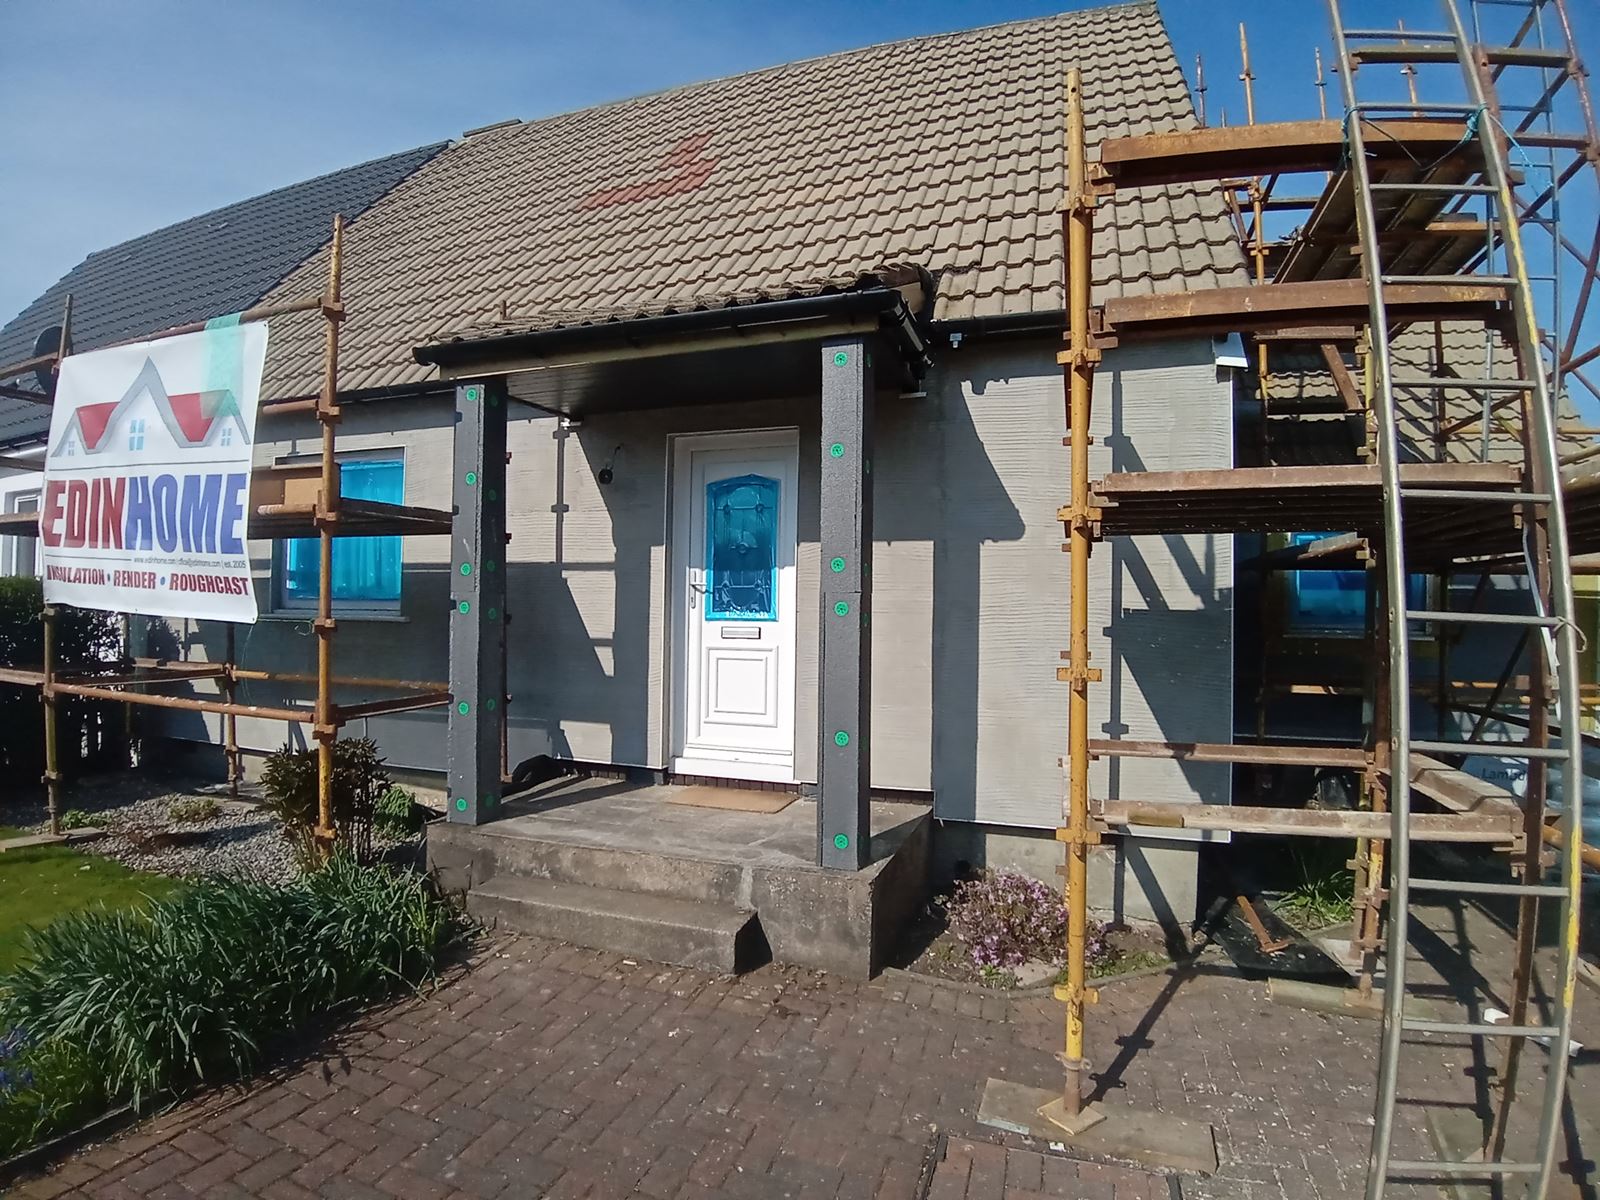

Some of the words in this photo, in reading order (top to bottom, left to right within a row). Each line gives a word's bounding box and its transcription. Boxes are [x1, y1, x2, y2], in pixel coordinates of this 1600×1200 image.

[43, 473, 247, 555] EDINHOME
[47, 564, 105, 586] INSULATION
[114, 570, 156, 590] RENDER
[169, 573, 249, 596] ROUGHCAST
